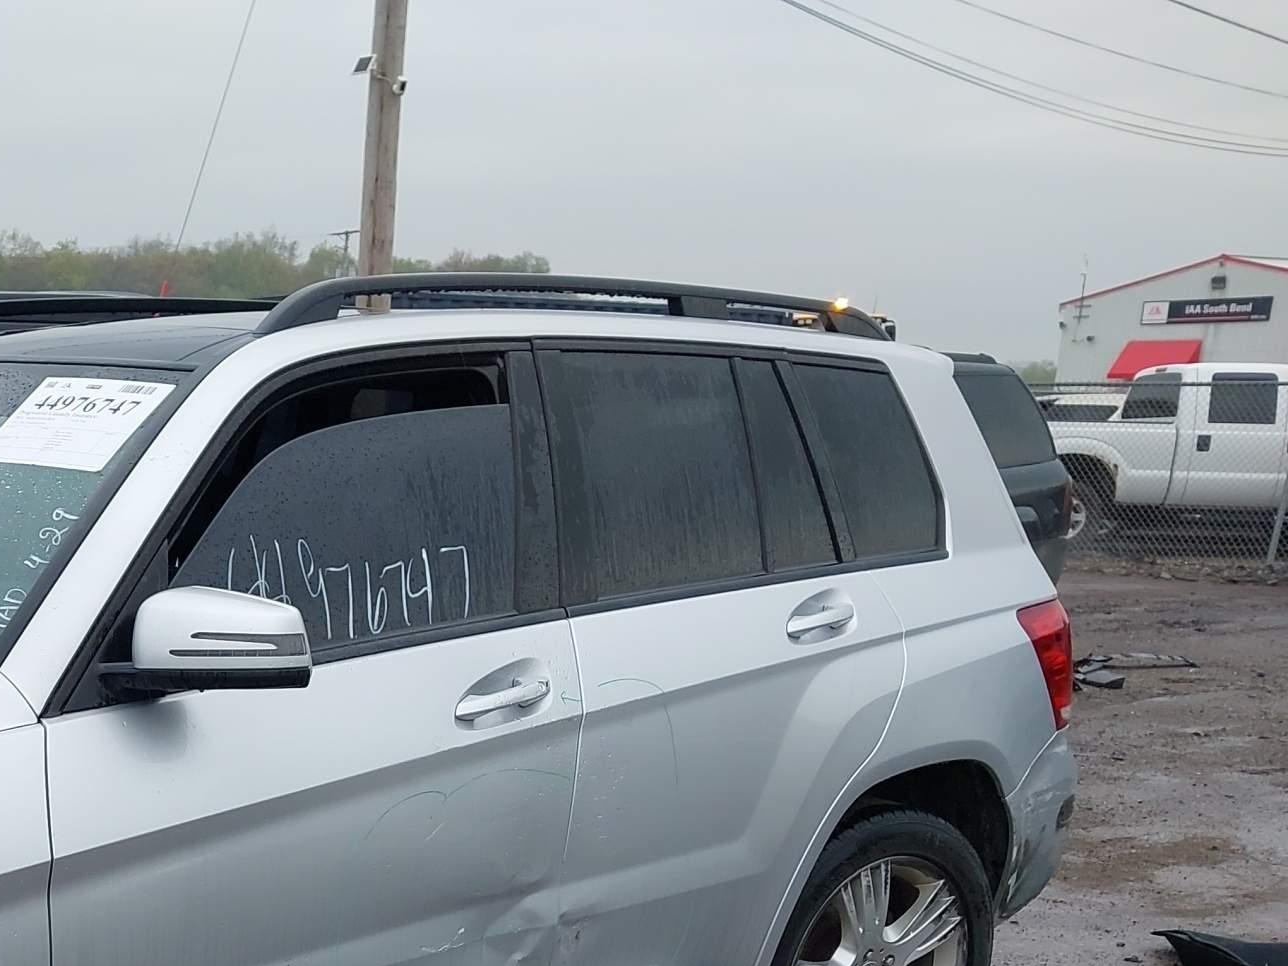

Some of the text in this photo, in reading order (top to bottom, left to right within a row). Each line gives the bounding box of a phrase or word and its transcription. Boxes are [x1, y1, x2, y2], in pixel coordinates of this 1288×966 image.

[1184, 302, 1253, 314] IAA South Bend
[34, 394, 141, 416] 44976747
